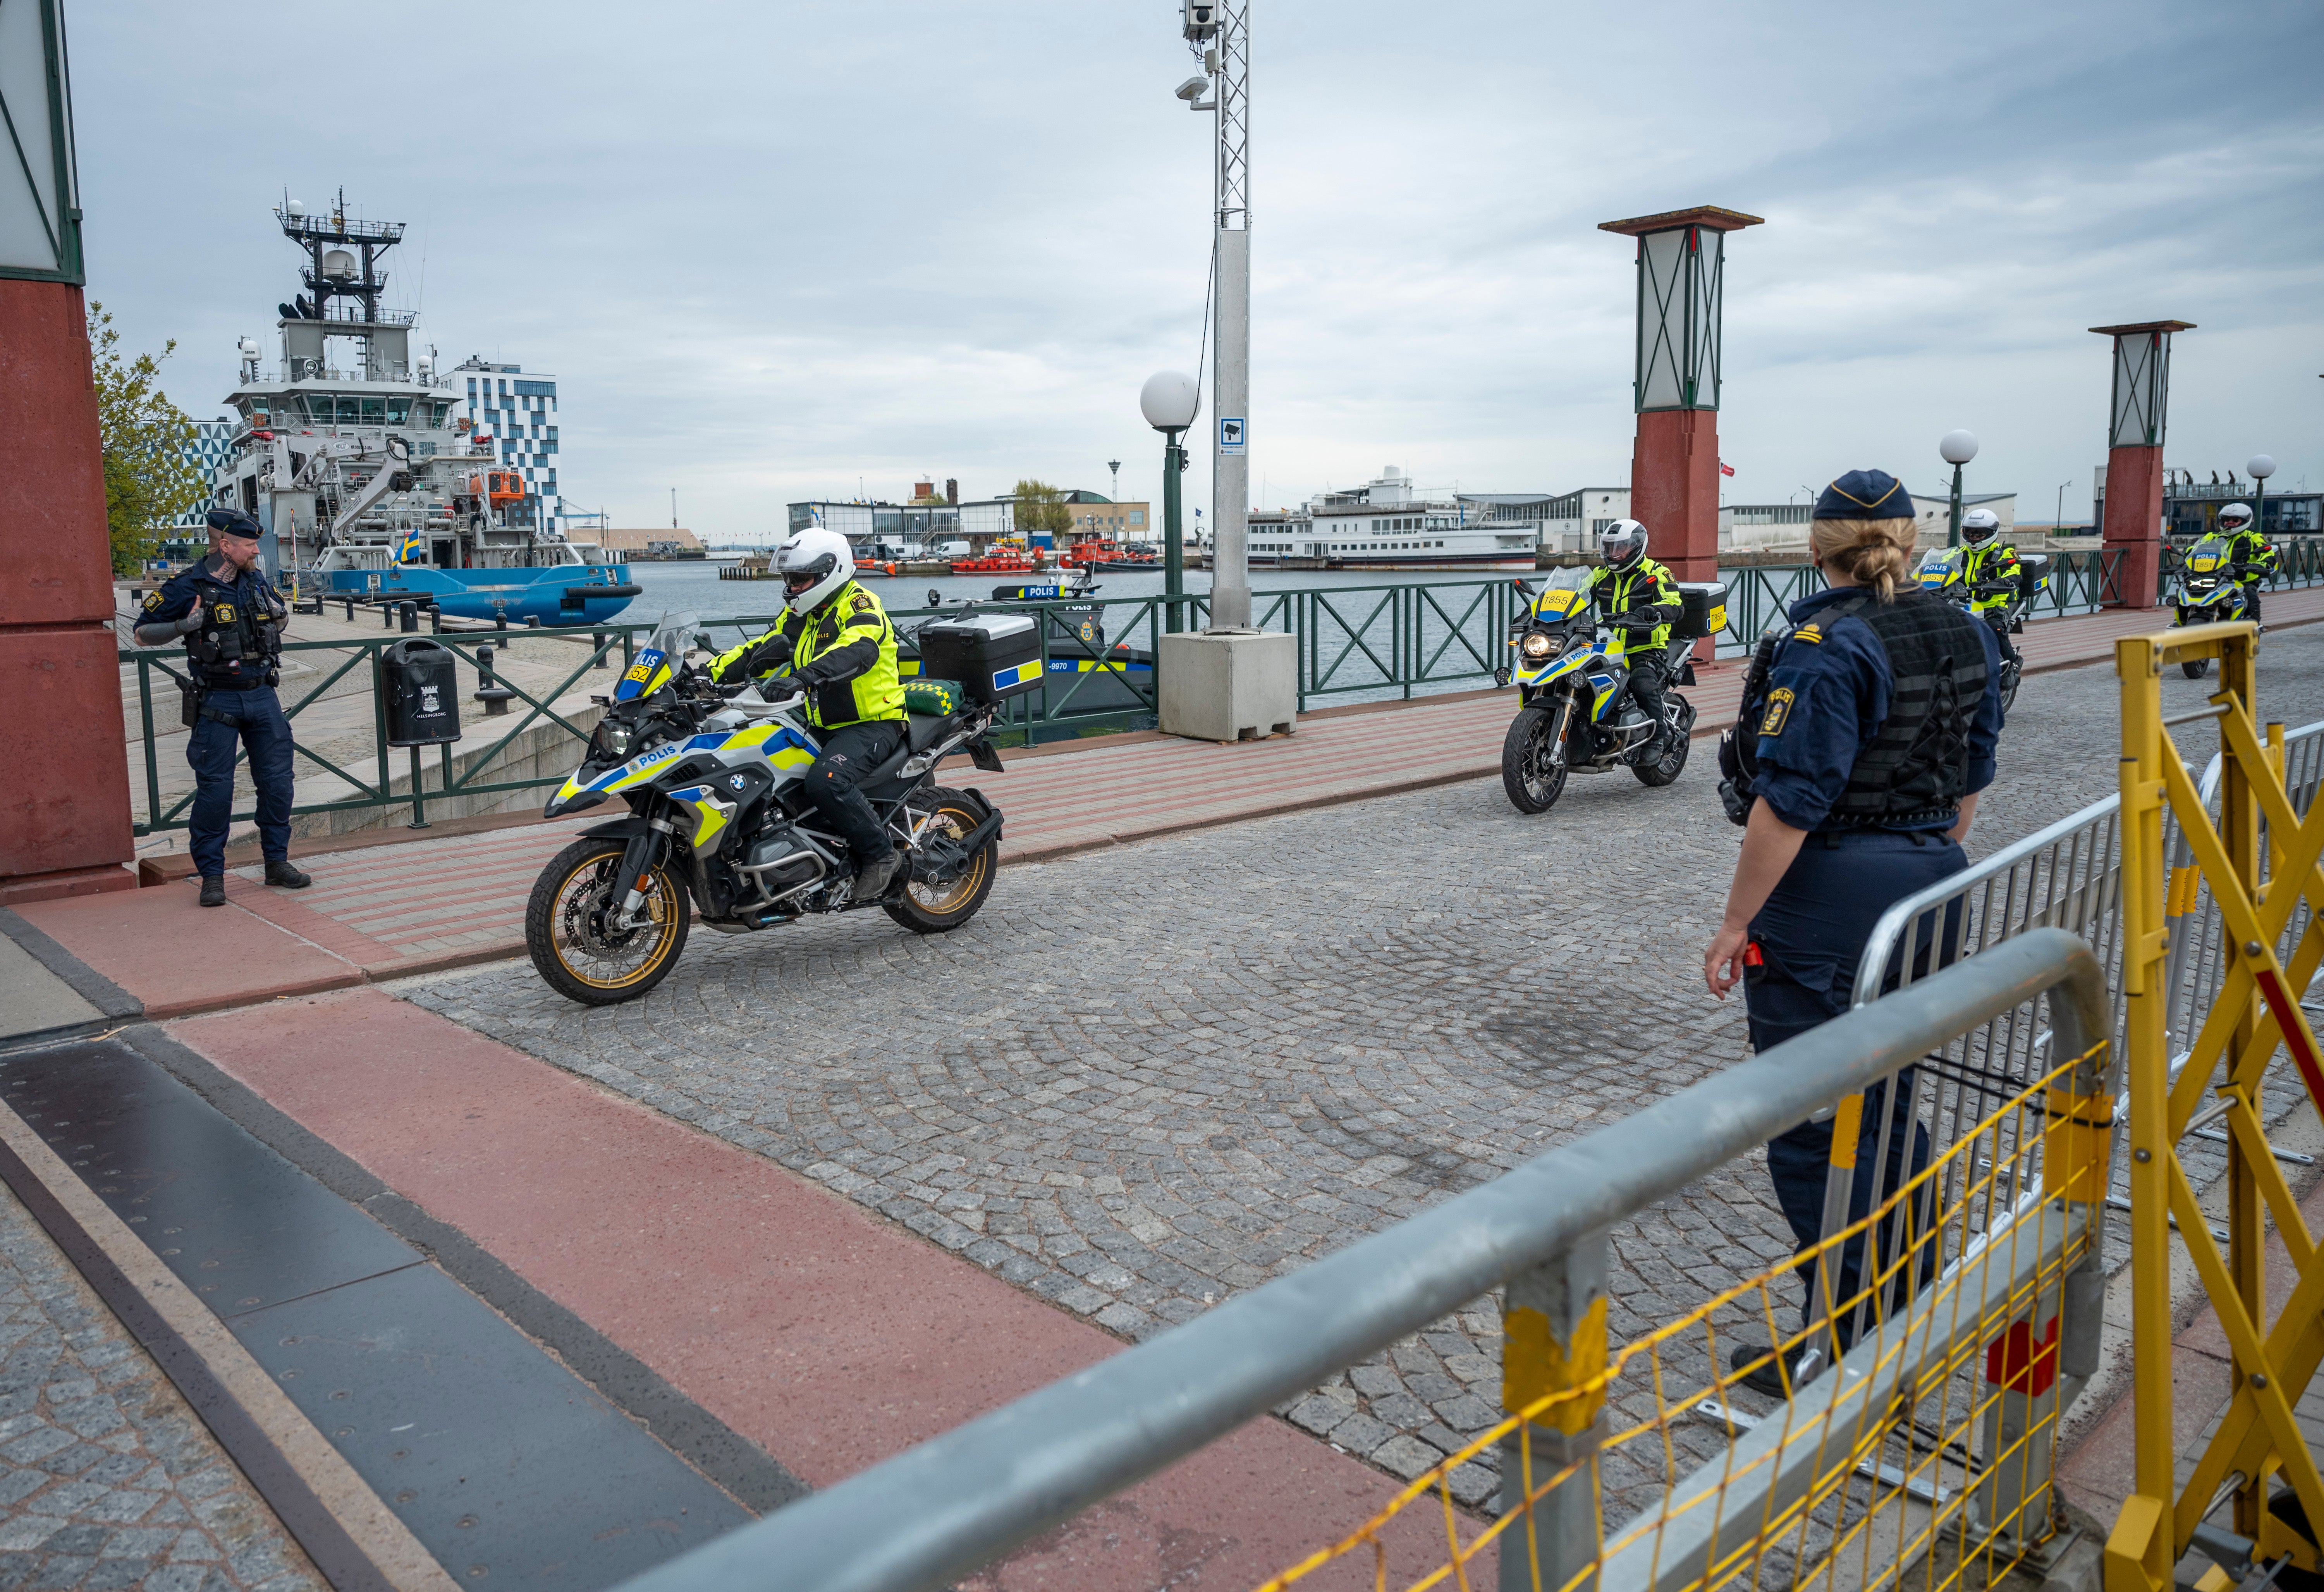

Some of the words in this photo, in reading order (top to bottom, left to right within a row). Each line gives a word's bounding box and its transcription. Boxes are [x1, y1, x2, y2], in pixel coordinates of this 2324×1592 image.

[1030, 587, 1054, 596] POLIS
[1545, 596, 1568, 605] T855
[1712, 611, 1722, 623] T855
[1571, 649, 1589, 660] POLIS
[1600, 683, 1613, 694] GS
[1770, 690, 1791, 704] POLIS
[639, 746, 676, 766] POLIS
[731, 775, 743, 783] BMW
